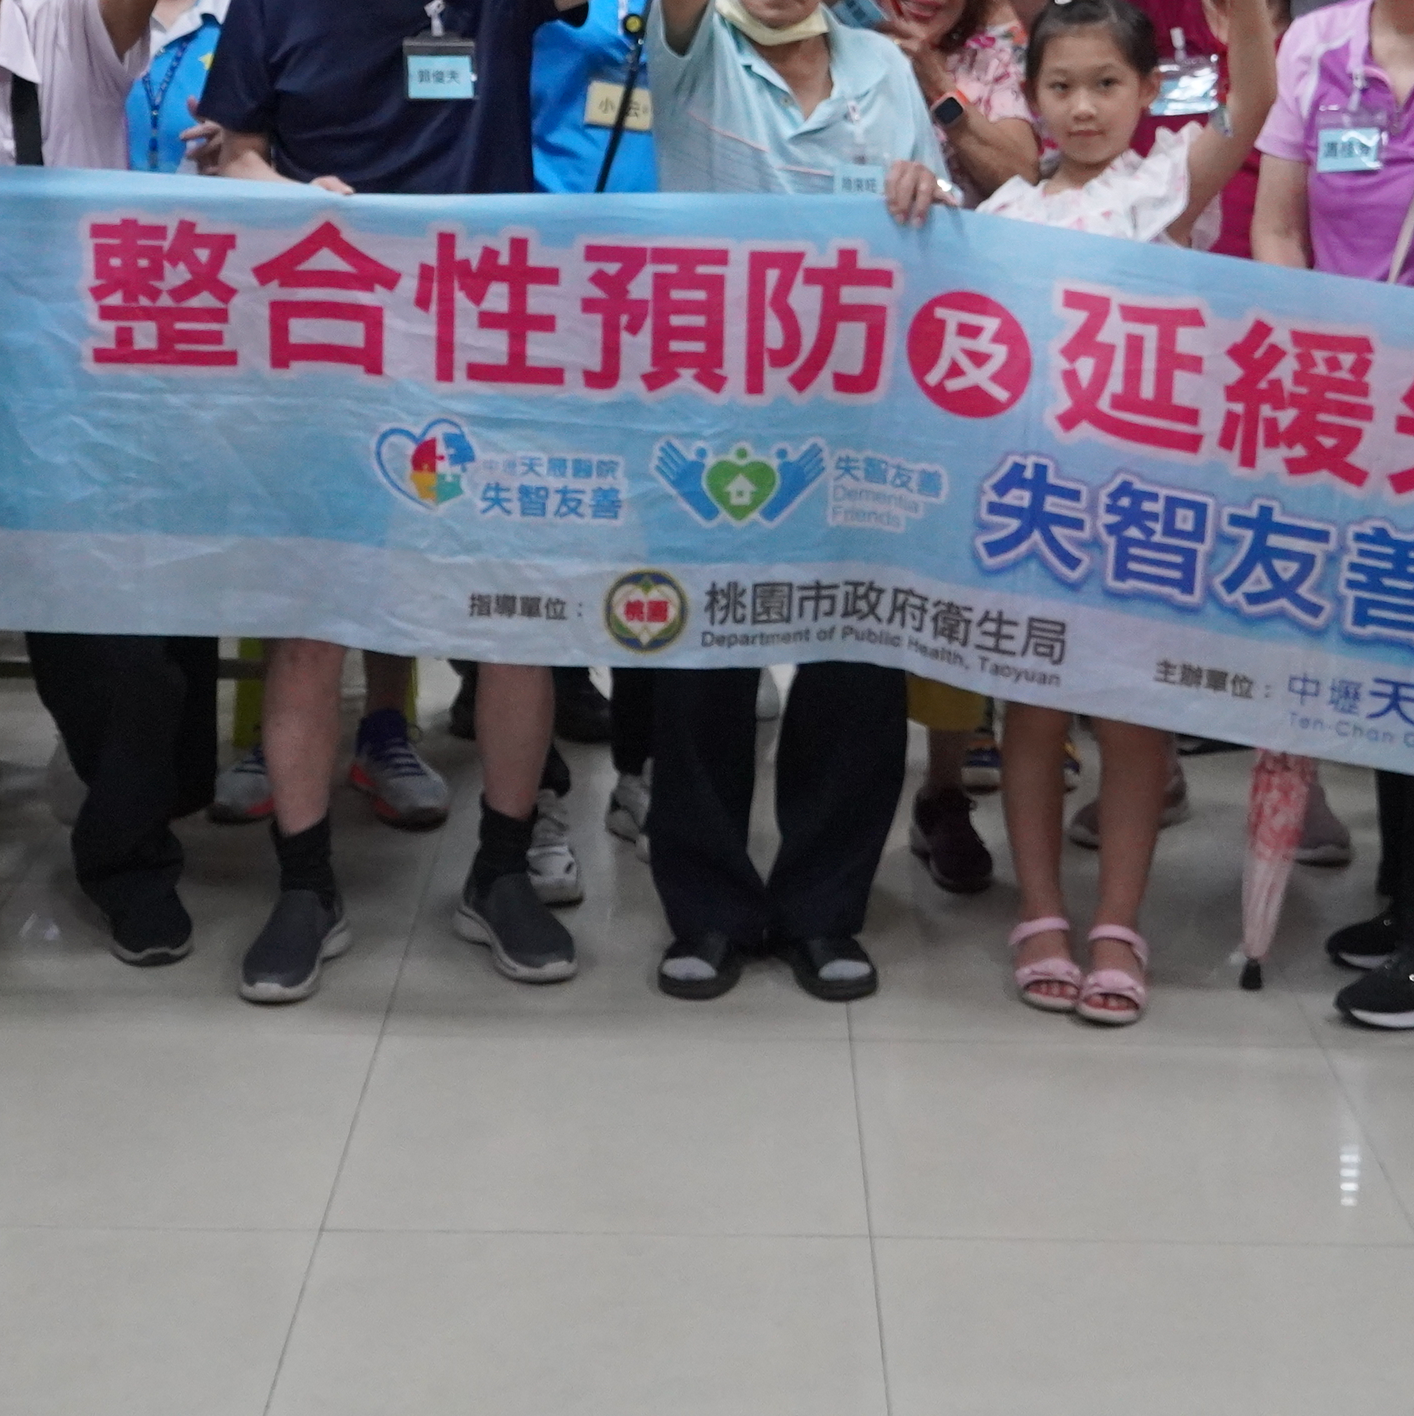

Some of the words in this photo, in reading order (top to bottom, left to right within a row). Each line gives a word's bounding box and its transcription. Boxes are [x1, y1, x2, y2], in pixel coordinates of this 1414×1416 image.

[833, 455, 943, 499] 失智友善
[480, 482, 623, 522] 失智友善
[623, 599, 670, 623] 桃園
[704, 580, 1067, 666] 桃園市政府衛生局
[701, 626, 810, 648] Department
[817, 625, 836, 641] of
[841, 625, 901, 648] Public
[907, 637, 969, 671] Health,
[978, 657, 1061, 687] Taoyuan
